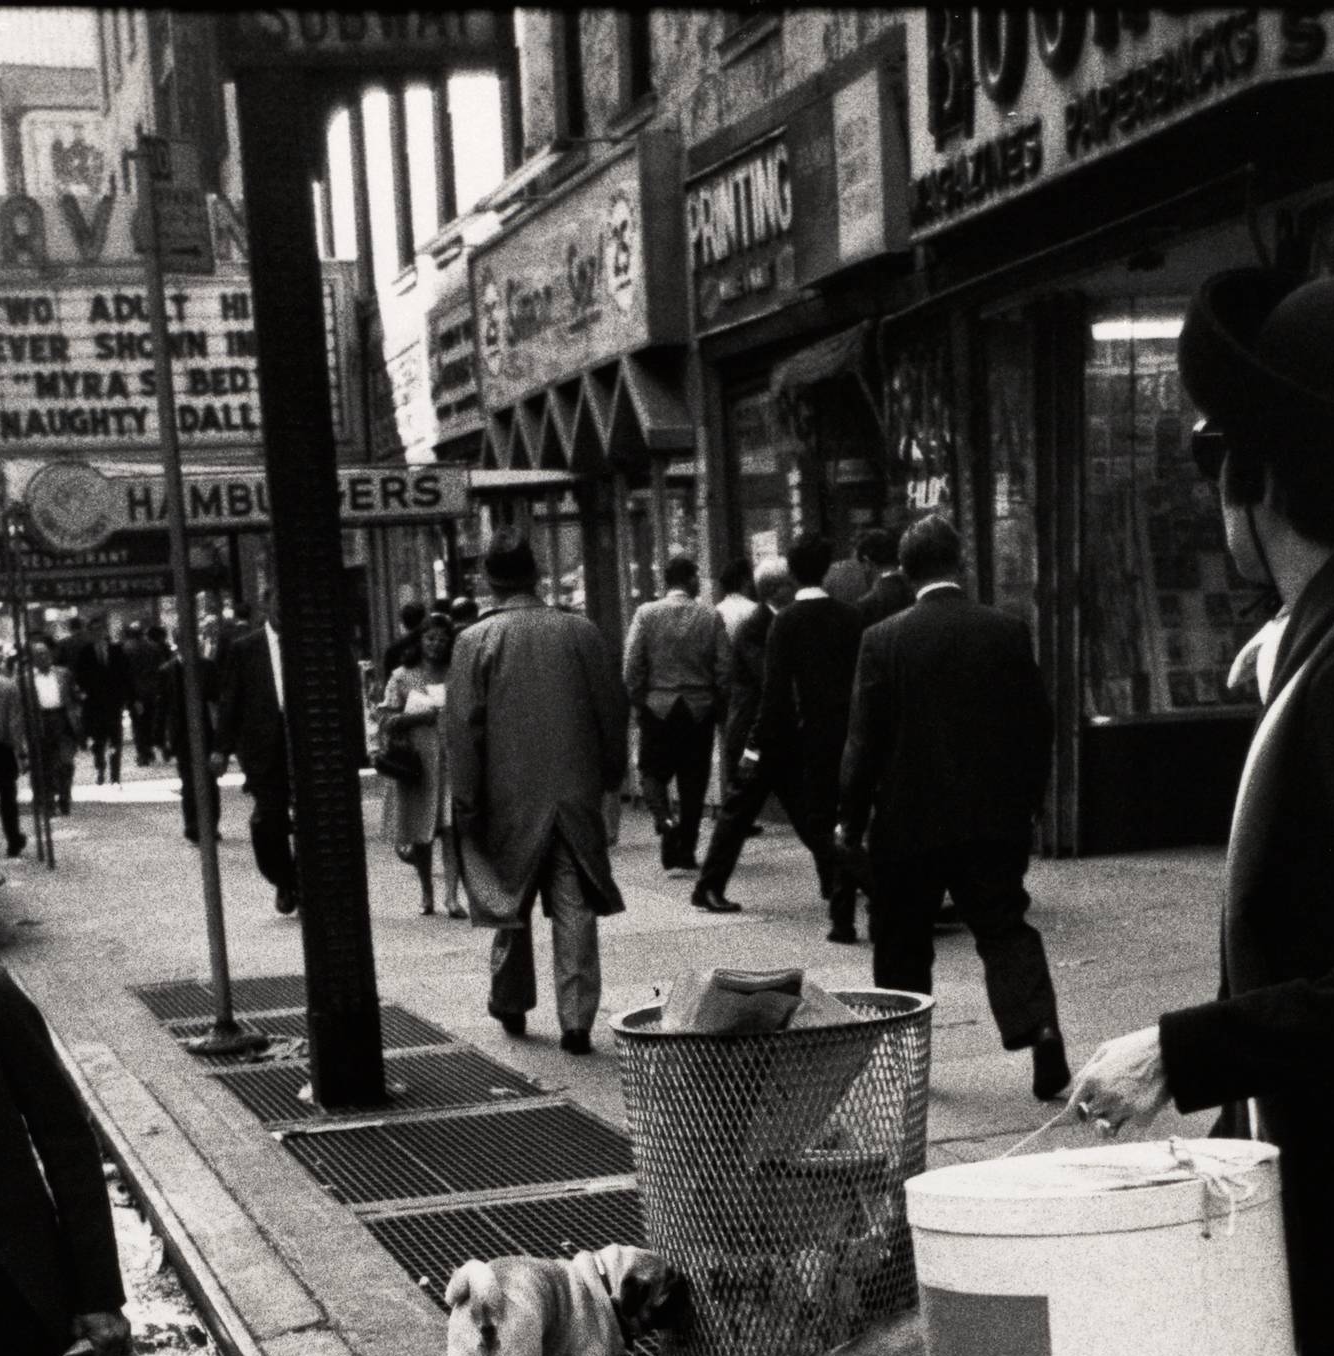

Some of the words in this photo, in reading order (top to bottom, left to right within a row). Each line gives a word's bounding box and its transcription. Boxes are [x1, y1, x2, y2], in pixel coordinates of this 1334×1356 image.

[686, 142, 793, 264] PRINTING
[88, 293, 189, 323] ADUT
[220, 291, 250, 321] HI
[178, 402, 259, 433] DALL
[126, 474, 443, 523] HMBUERS
